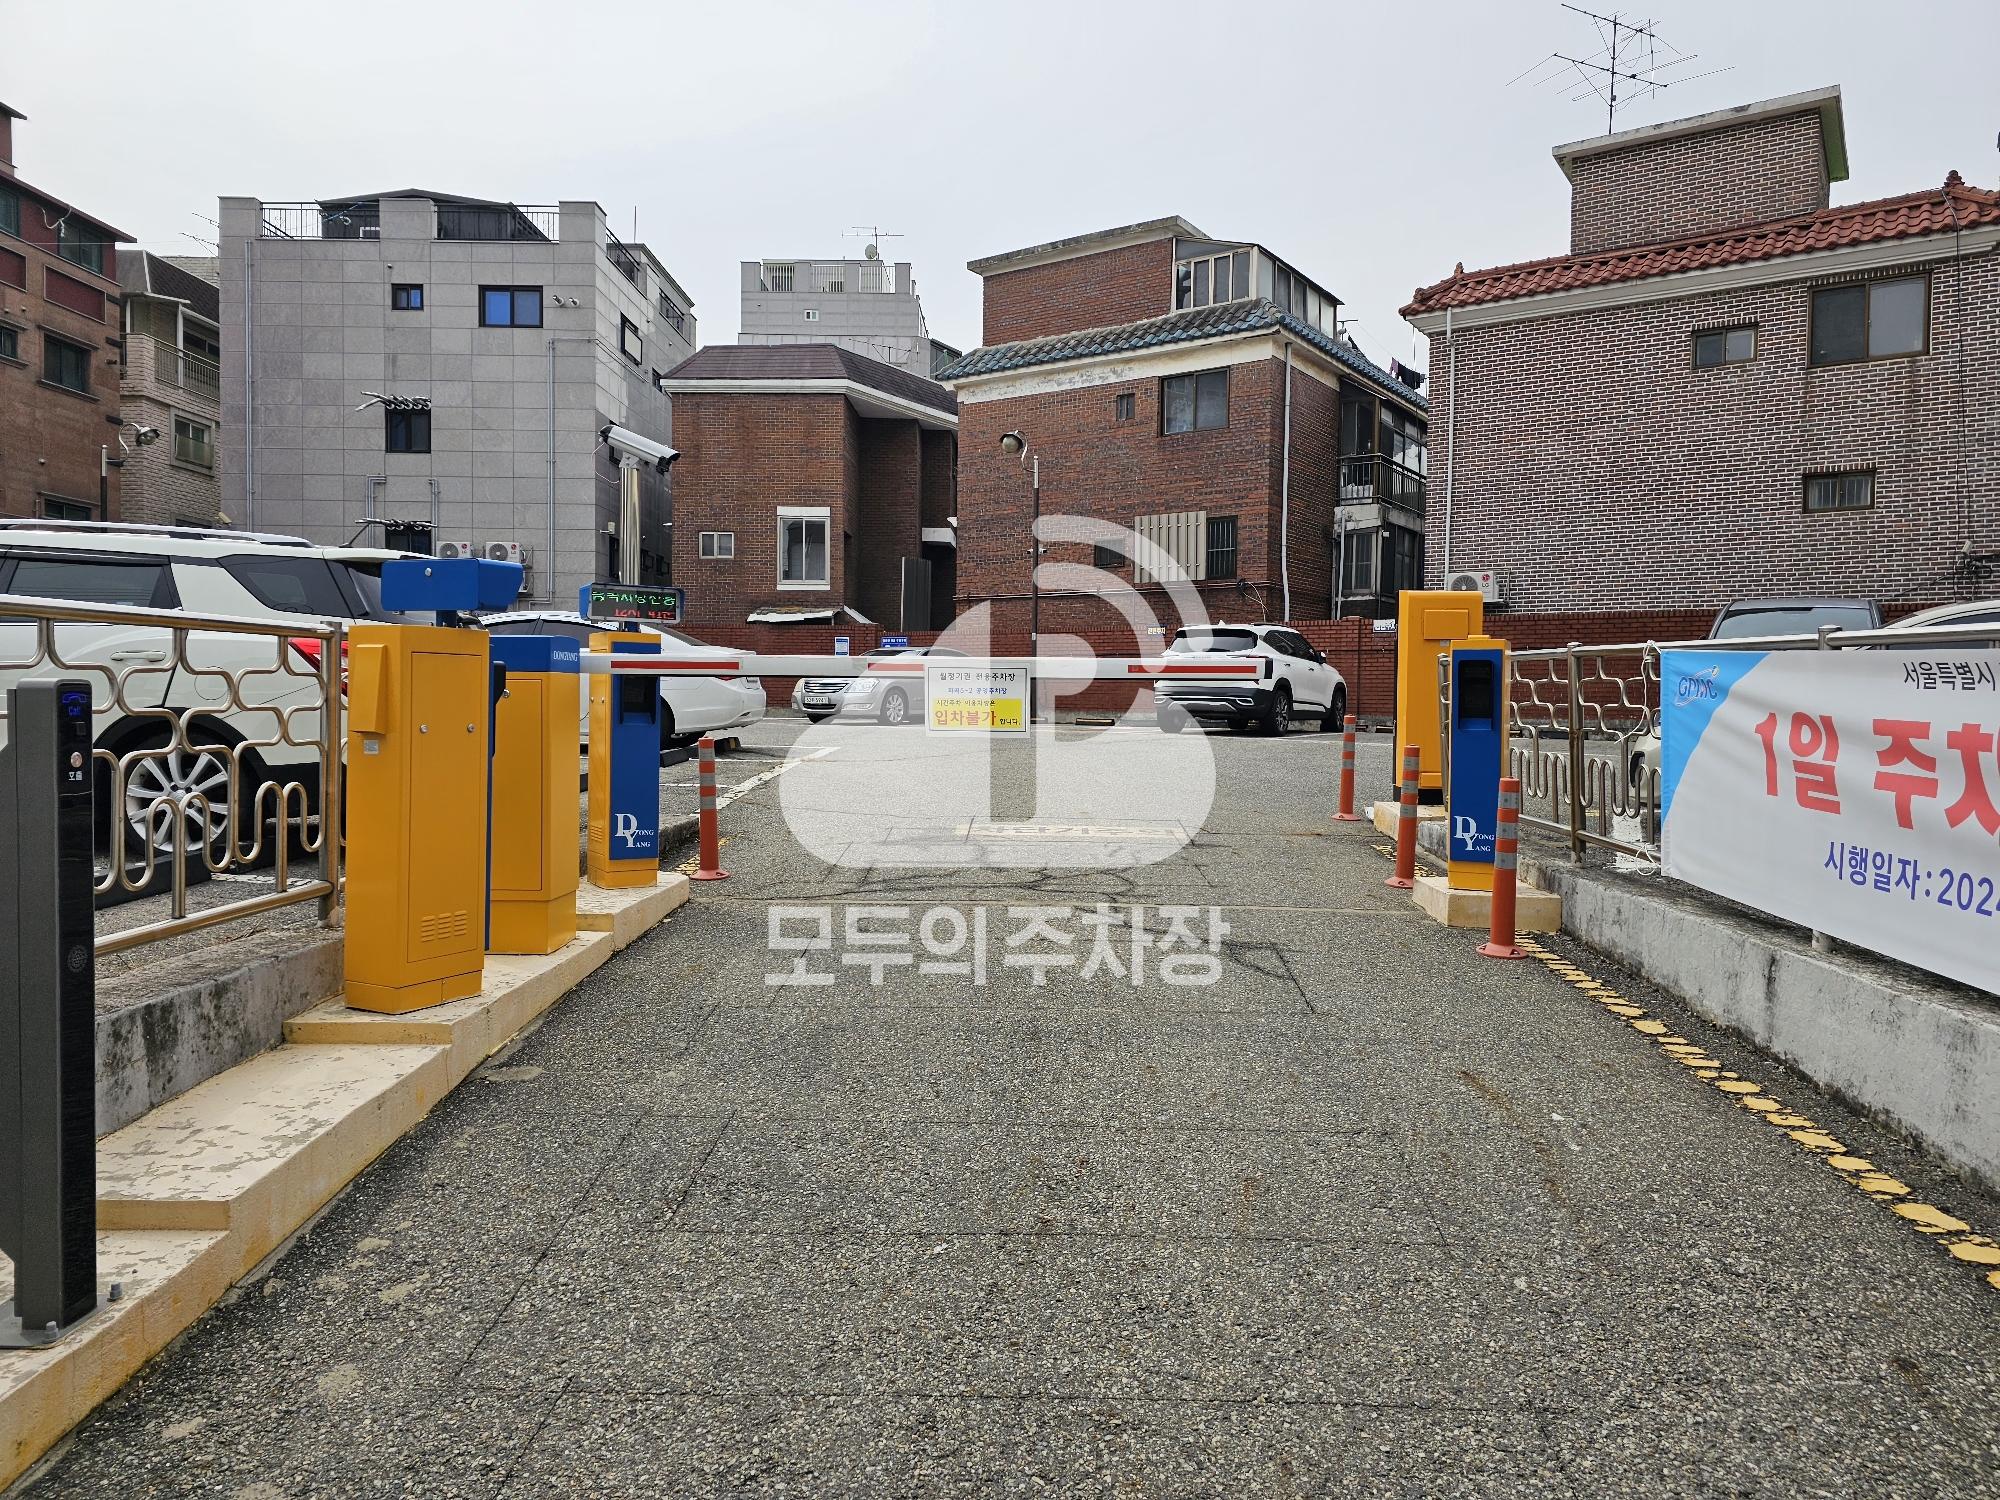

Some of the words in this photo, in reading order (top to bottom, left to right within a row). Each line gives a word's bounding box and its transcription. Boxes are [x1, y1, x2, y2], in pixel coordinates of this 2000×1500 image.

[553, 650, 578, 662] DONGYANG
[1903, 661, 1996, 691] 서울특별시
[935, 710, 997, 726] 입차불가
[1754, 711, 1842, 815] 1일
[1823, 841, 2000, 917] 시행일자:202
